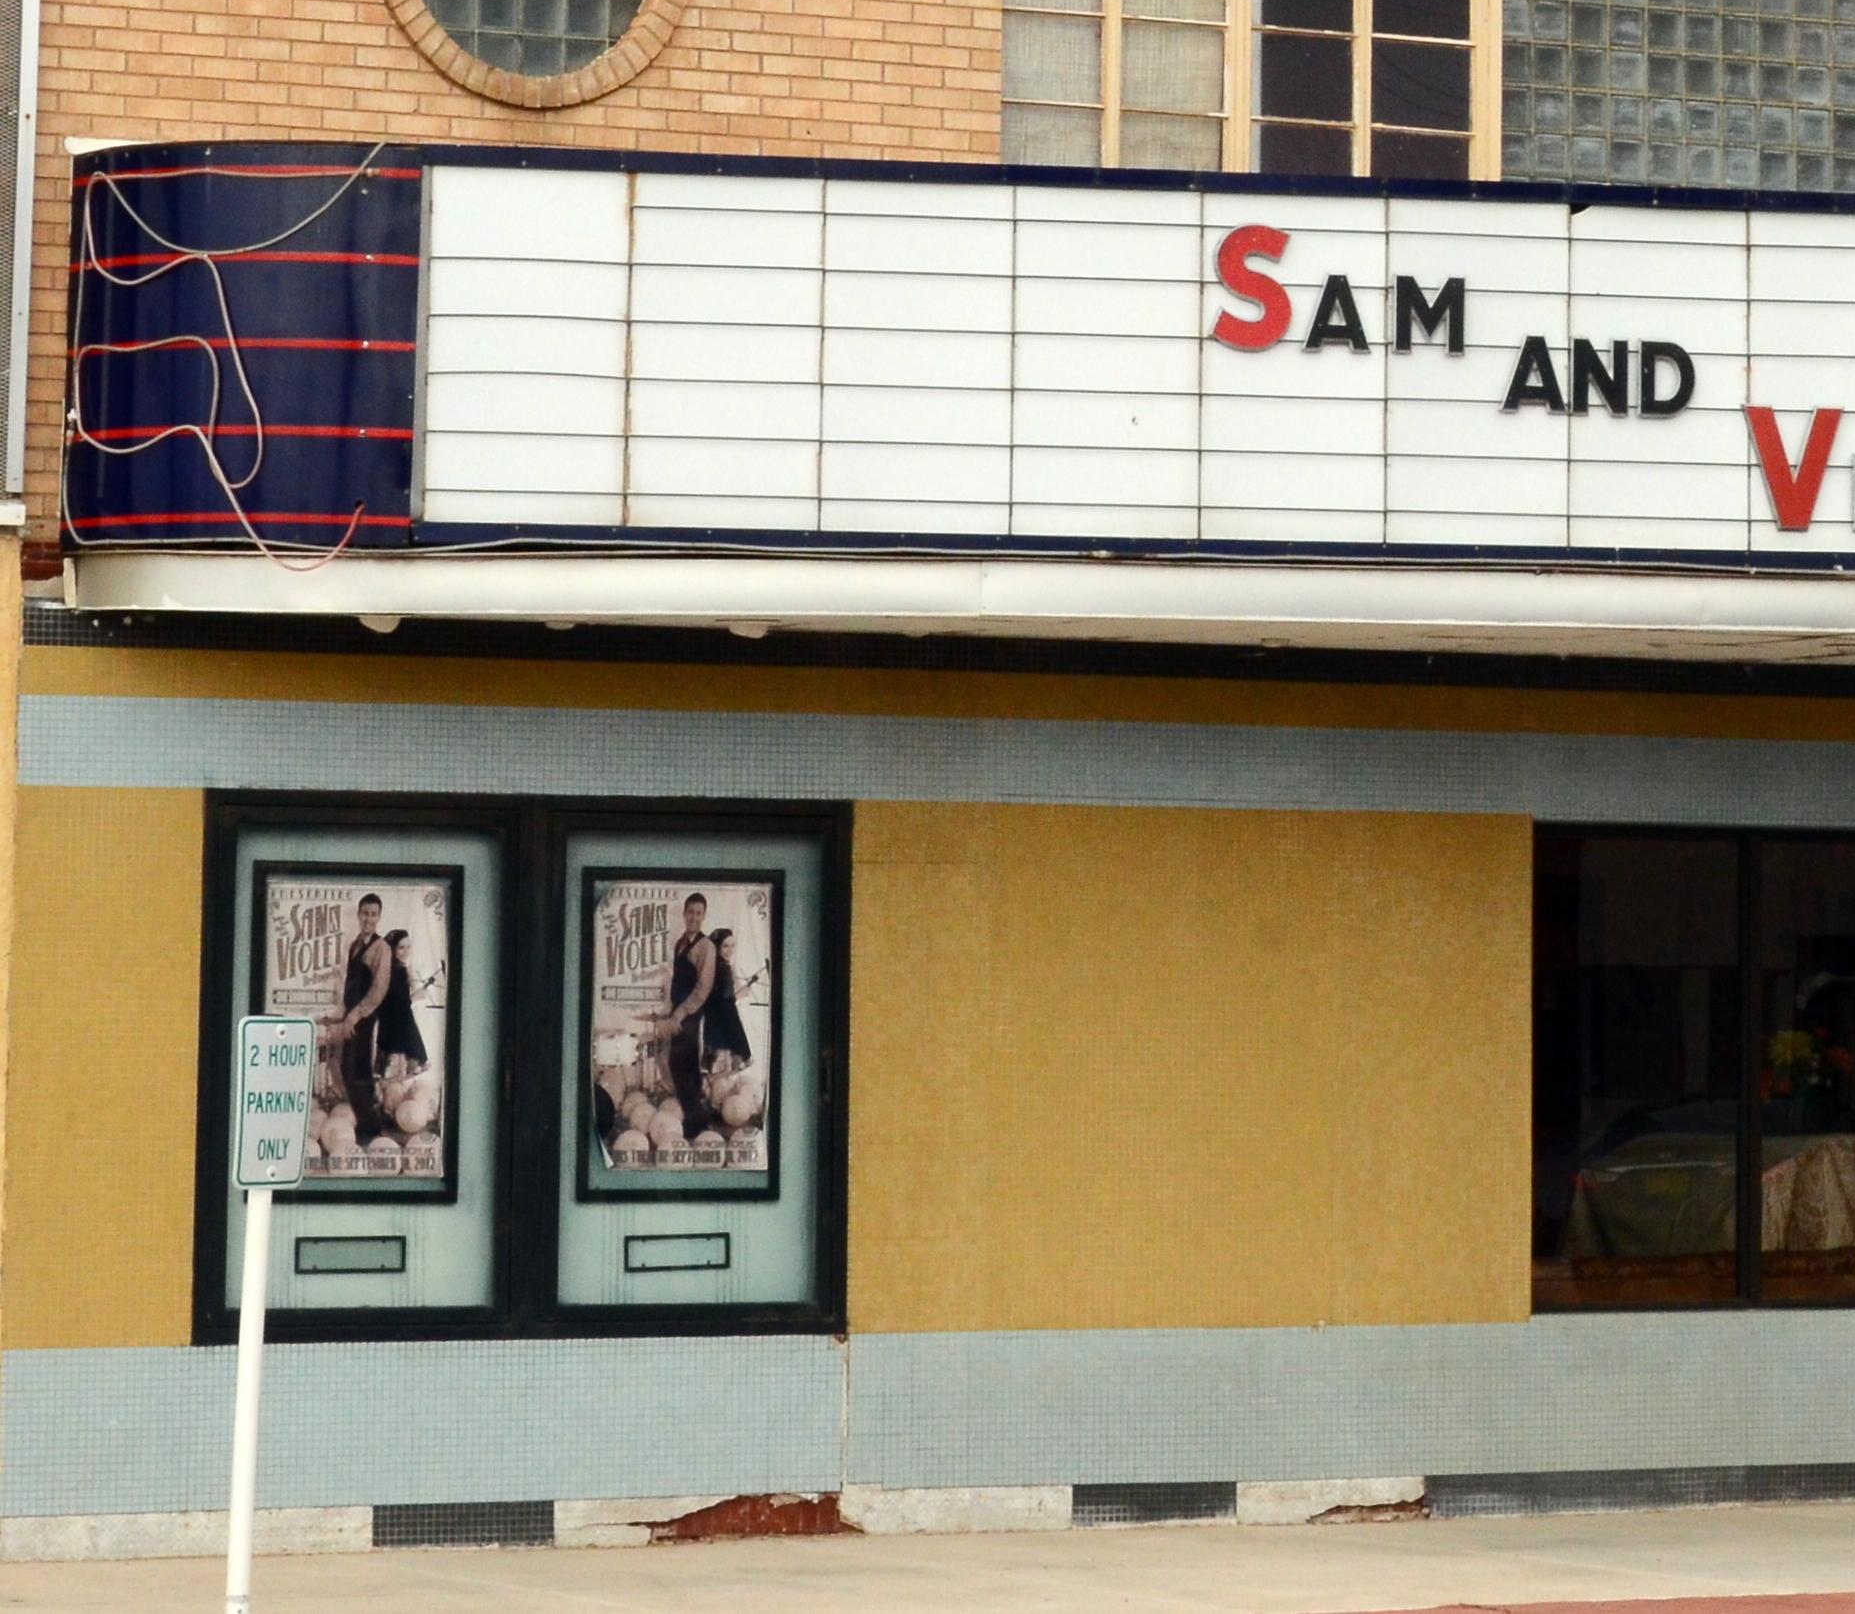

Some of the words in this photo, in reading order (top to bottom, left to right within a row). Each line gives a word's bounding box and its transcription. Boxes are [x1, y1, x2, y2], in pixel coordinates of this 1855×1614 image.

[1212, 224, 1467, 356] SAM
[1500, 335, 1697, 419] AND
[275, 932, 344, 981] VIOLET
[605, 930, 670, 978] VIOLET
[250, 1044, 260, 1067] 2
[268, 1044, 307, 1067] HOUR
[247, 1091, 306, 1114] PARKING
[257, 1138, 290, 1161] ONLY
